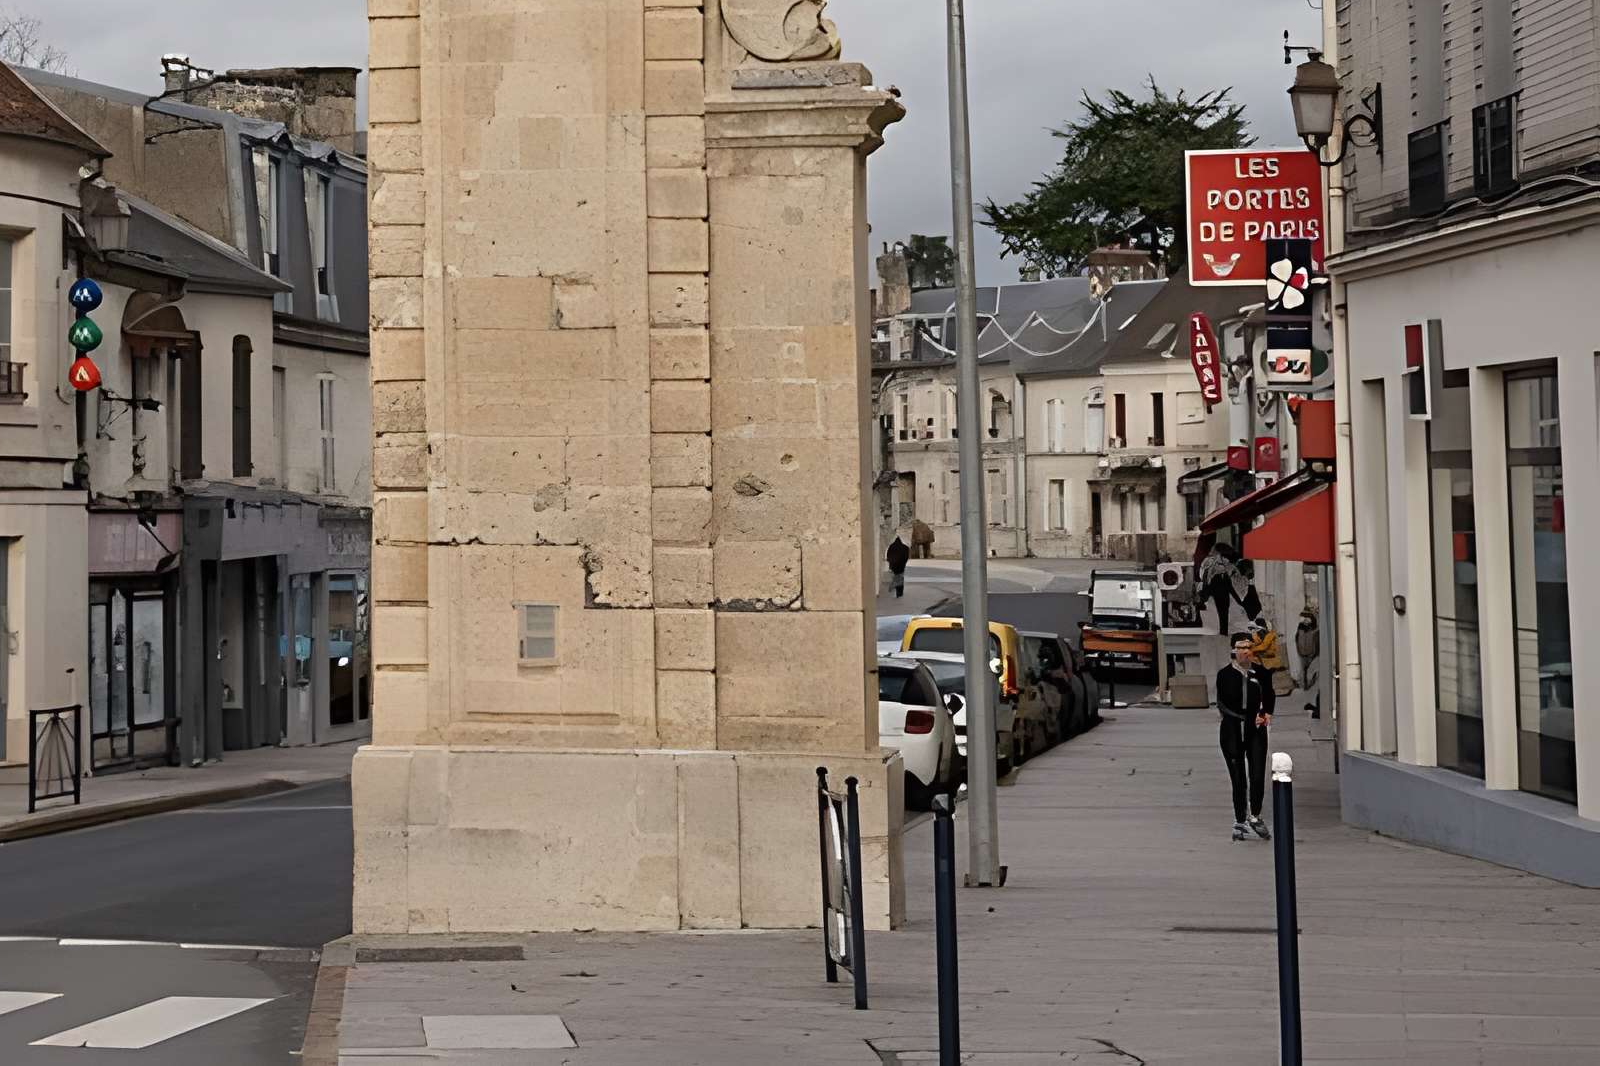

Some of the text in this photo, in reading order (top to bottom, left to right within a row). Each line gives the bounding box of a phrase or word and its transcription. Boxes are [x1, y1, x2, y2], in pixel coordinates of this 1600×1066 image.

[1234, 157, 1280, 179] LES
[1206, 186, 1311, 211] PORTES
[1199, 218, 1320, 243] DE PARIS
